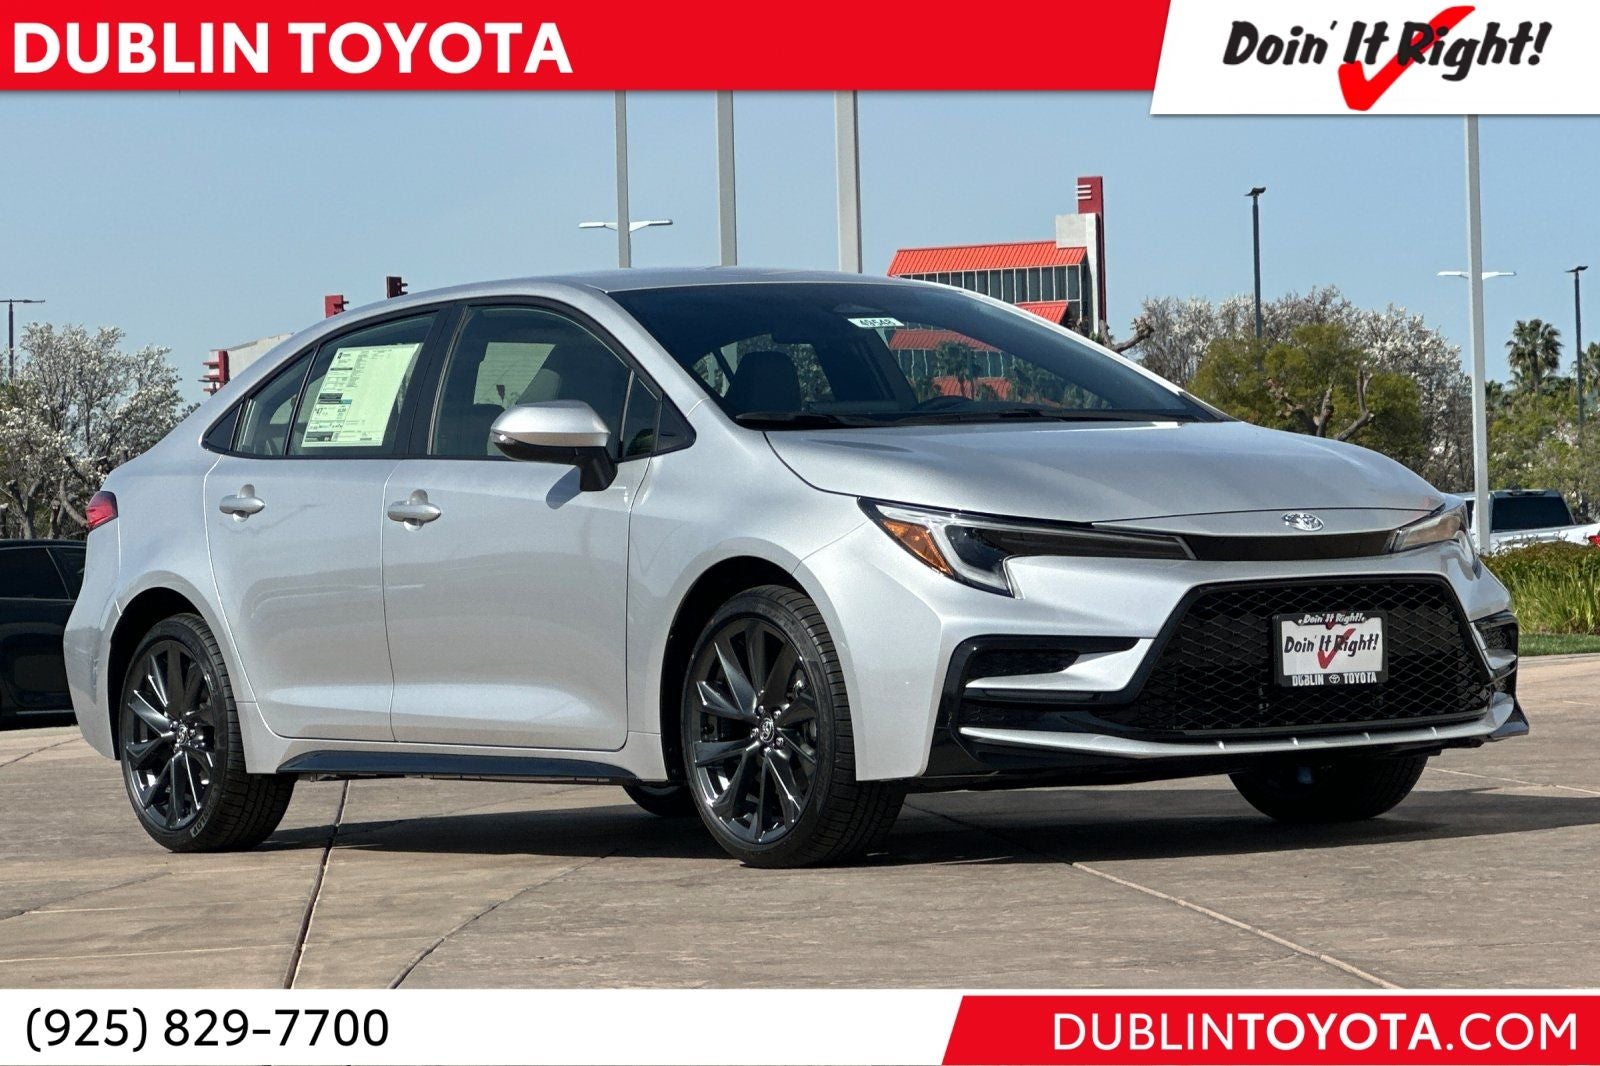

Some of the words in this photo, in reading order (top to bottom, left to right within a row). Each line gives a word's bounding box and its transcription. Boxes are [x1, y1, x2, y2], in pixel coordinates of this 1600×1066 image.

[1303, 613, 1325, 624] Doin'
[1325, 613, 1335, 623] It
[1335, 612, 1364, 625] Right!
[1284, 634, 1316, 654] Doin'
[1319, 634, 1331, 652] It
[1334, 633, 1379, 657] Right!
[1292, 674, 1325, 687] DUBLIN
[1343, 671, 1378, 684] TOYOTA
